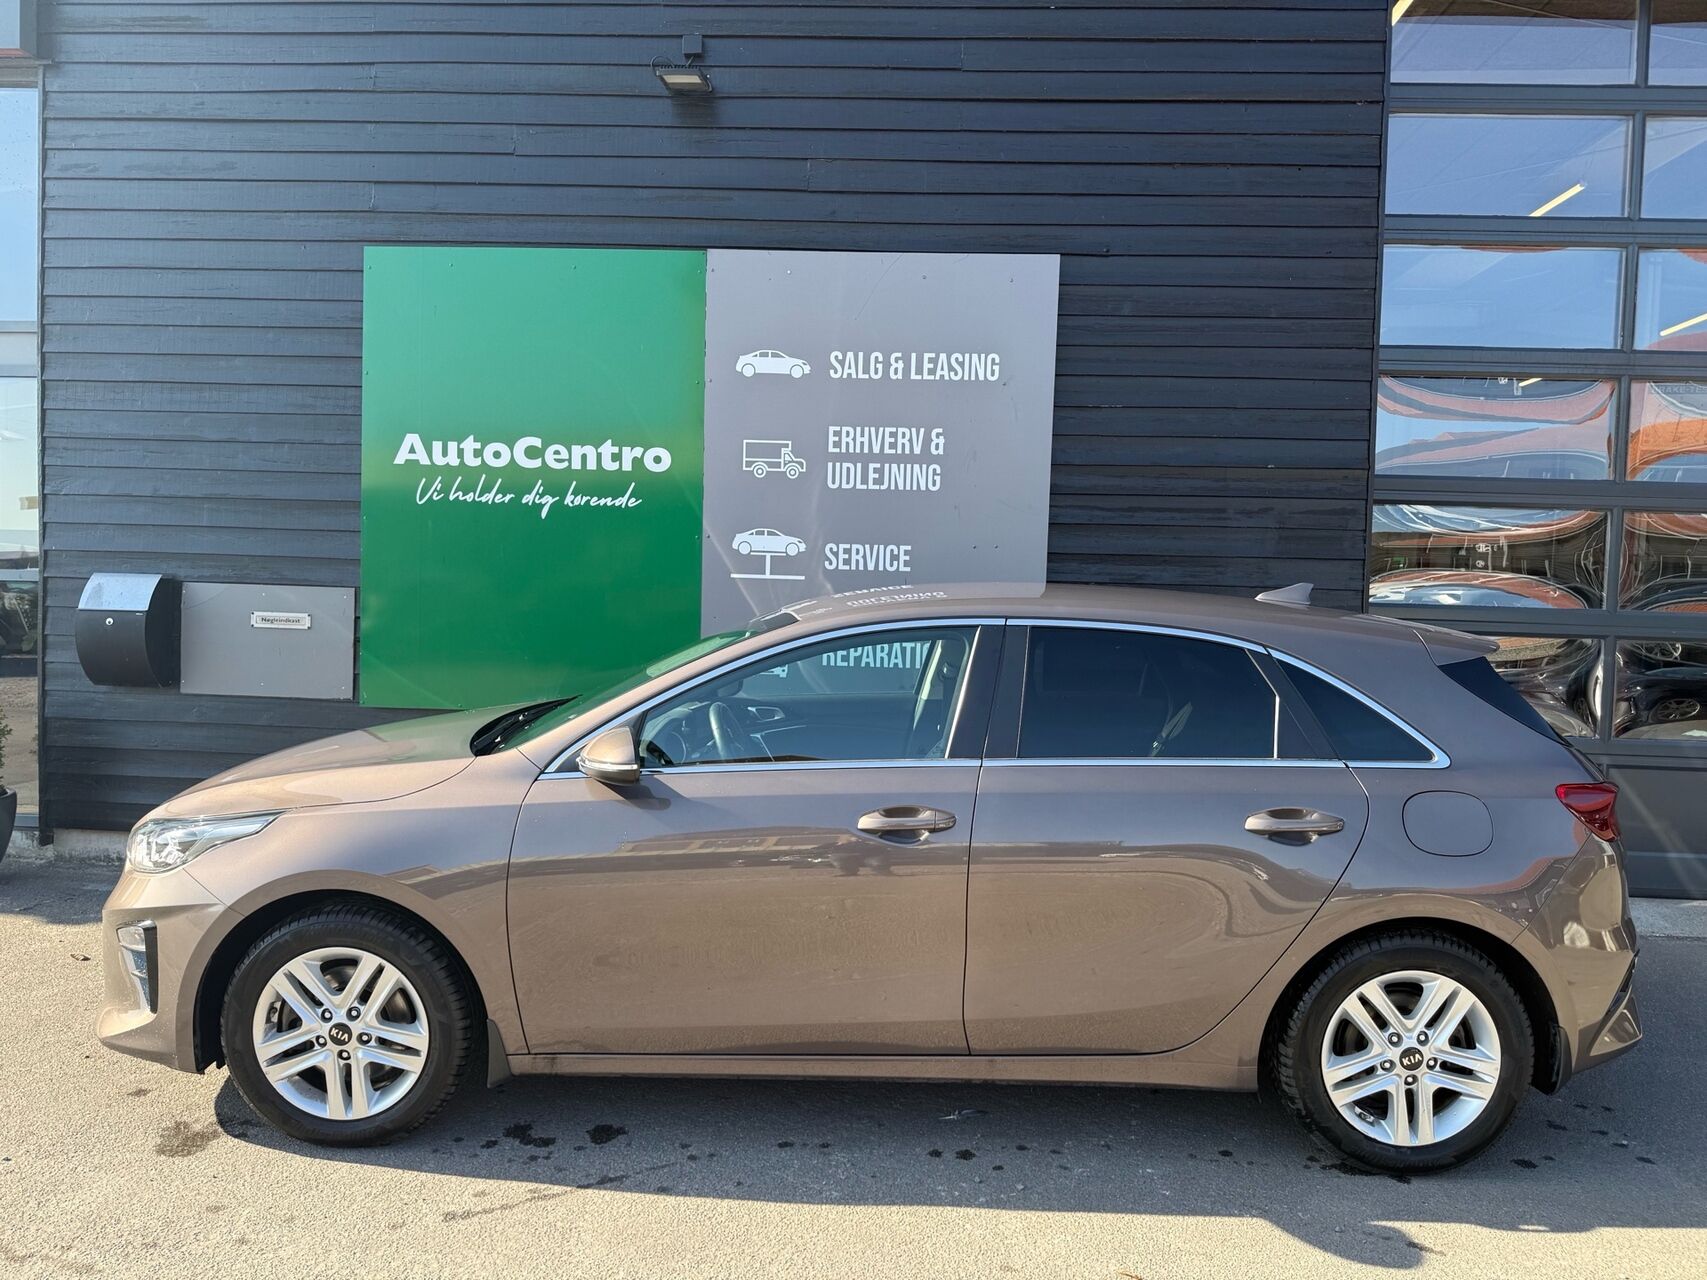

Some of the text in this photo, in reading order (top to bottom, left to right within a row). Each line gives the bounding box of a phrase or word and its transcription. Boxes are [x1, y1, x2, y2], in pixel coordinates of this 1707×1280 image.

[829, 351, 1000, 381] SALG & LEASING
[393, 433, 672, 473] AutoCentro
[828, 426, 945, 455] ERHVERV &
[827, 462, 941, 491] UDLEJNING
[416, 474, 642, 519] Vi holder dig kørende
[824, 543, 912, 572] SERVICE
[330, 1028, 349, 1042] KIA
[1402, 1054, 1422, 1066] KIA
